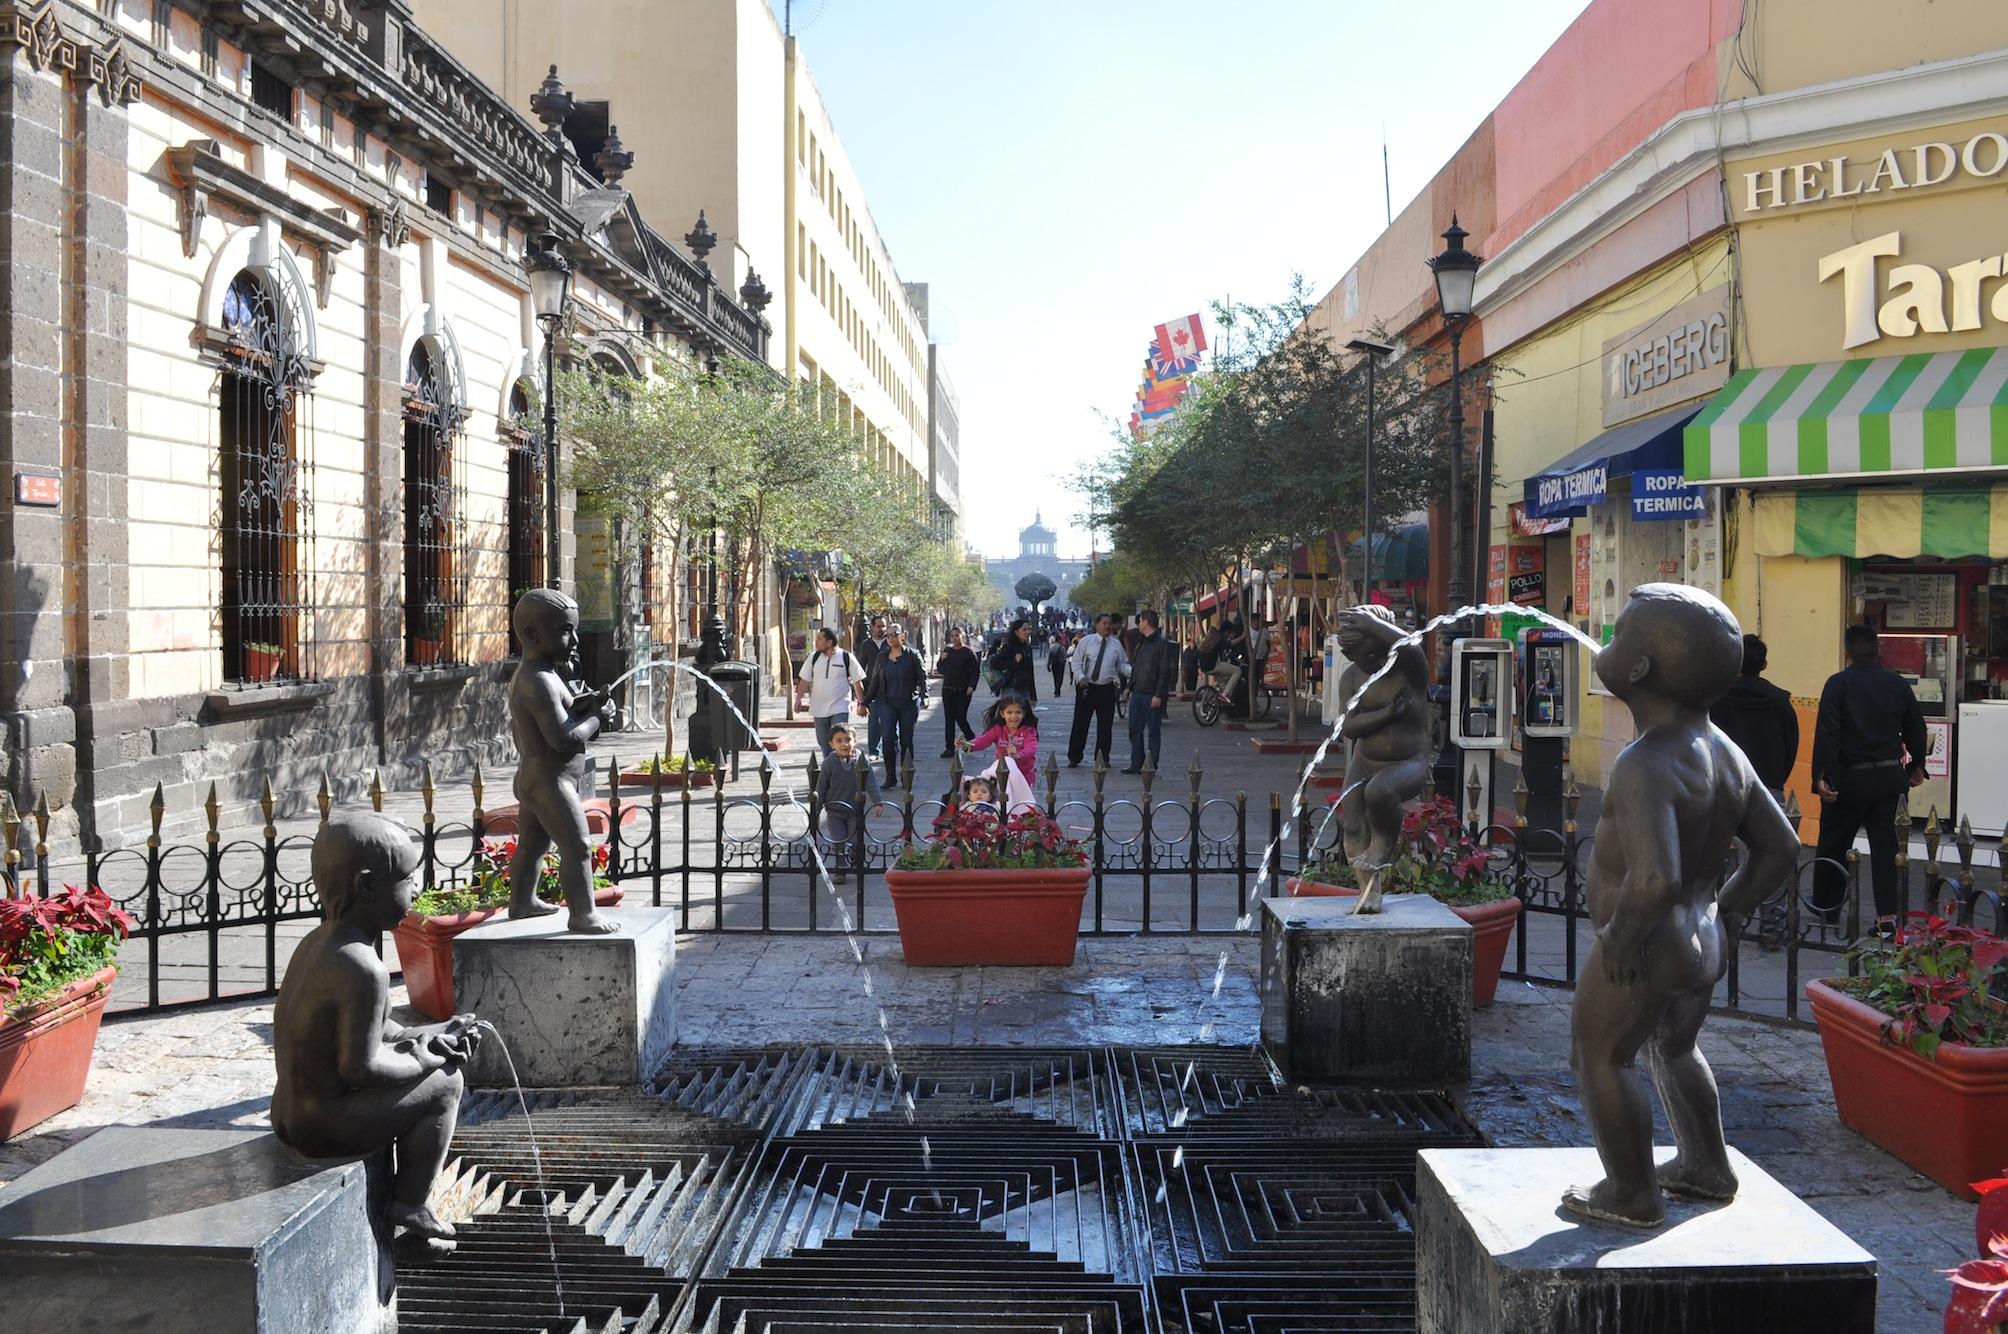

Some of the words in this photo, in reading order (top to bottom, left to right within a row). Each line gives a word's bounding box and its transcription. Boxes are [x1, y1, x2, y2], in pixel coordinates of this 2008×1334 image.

[1623, 312, 1727, 398] ICEBERG
[1539, 478, 1562, 507] ROPA
[1564, 467, 1607, 500] TERMICA
[1645, 475, 1687, 491] ROPA
[1634, 496, 1705, 513] TERMICA
[1510, 573, 1541, 589] POLLO
